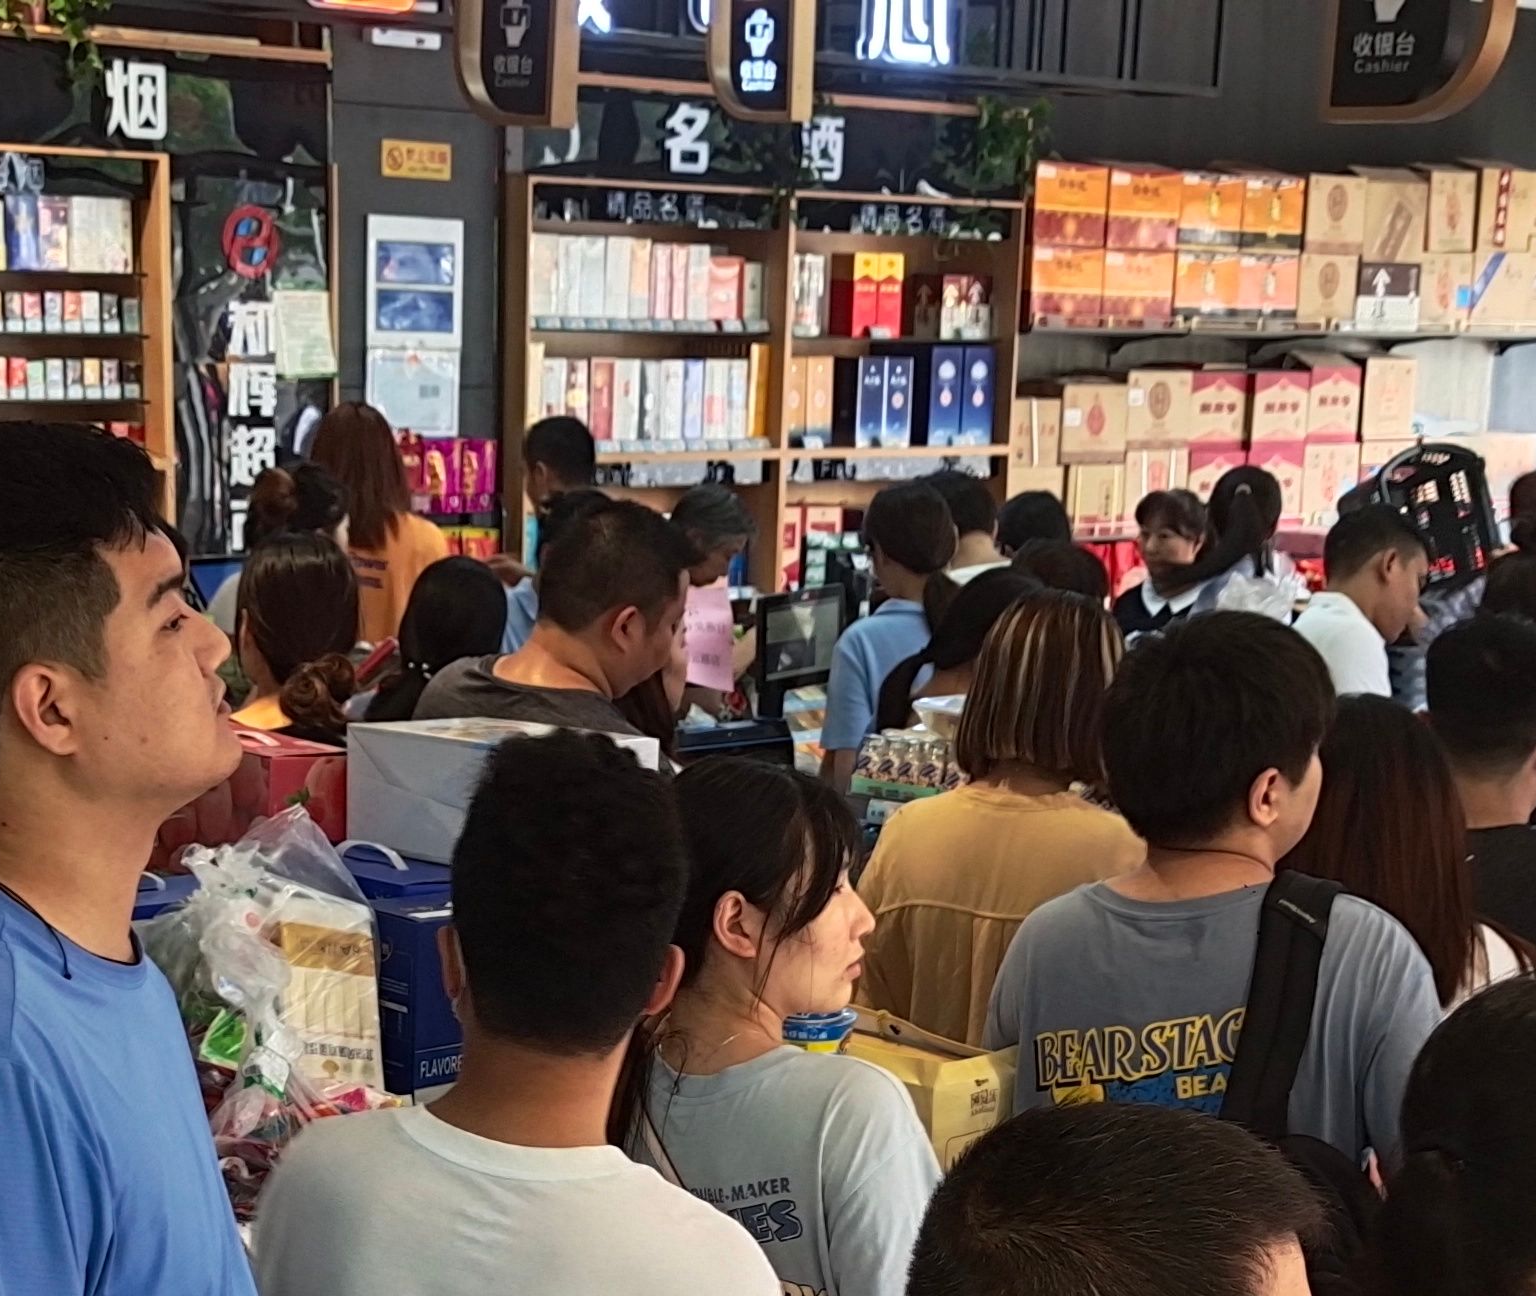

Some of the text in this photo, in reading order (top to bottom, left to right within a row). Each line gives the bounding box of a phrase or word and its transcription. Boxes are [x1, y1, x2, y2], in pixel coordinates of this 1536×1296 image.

[1353, 32, 1415, 58] 收银台
[1353, 57, 1411, 75] Cashier
[1035, 1024, 1145, 1092] BEAR
